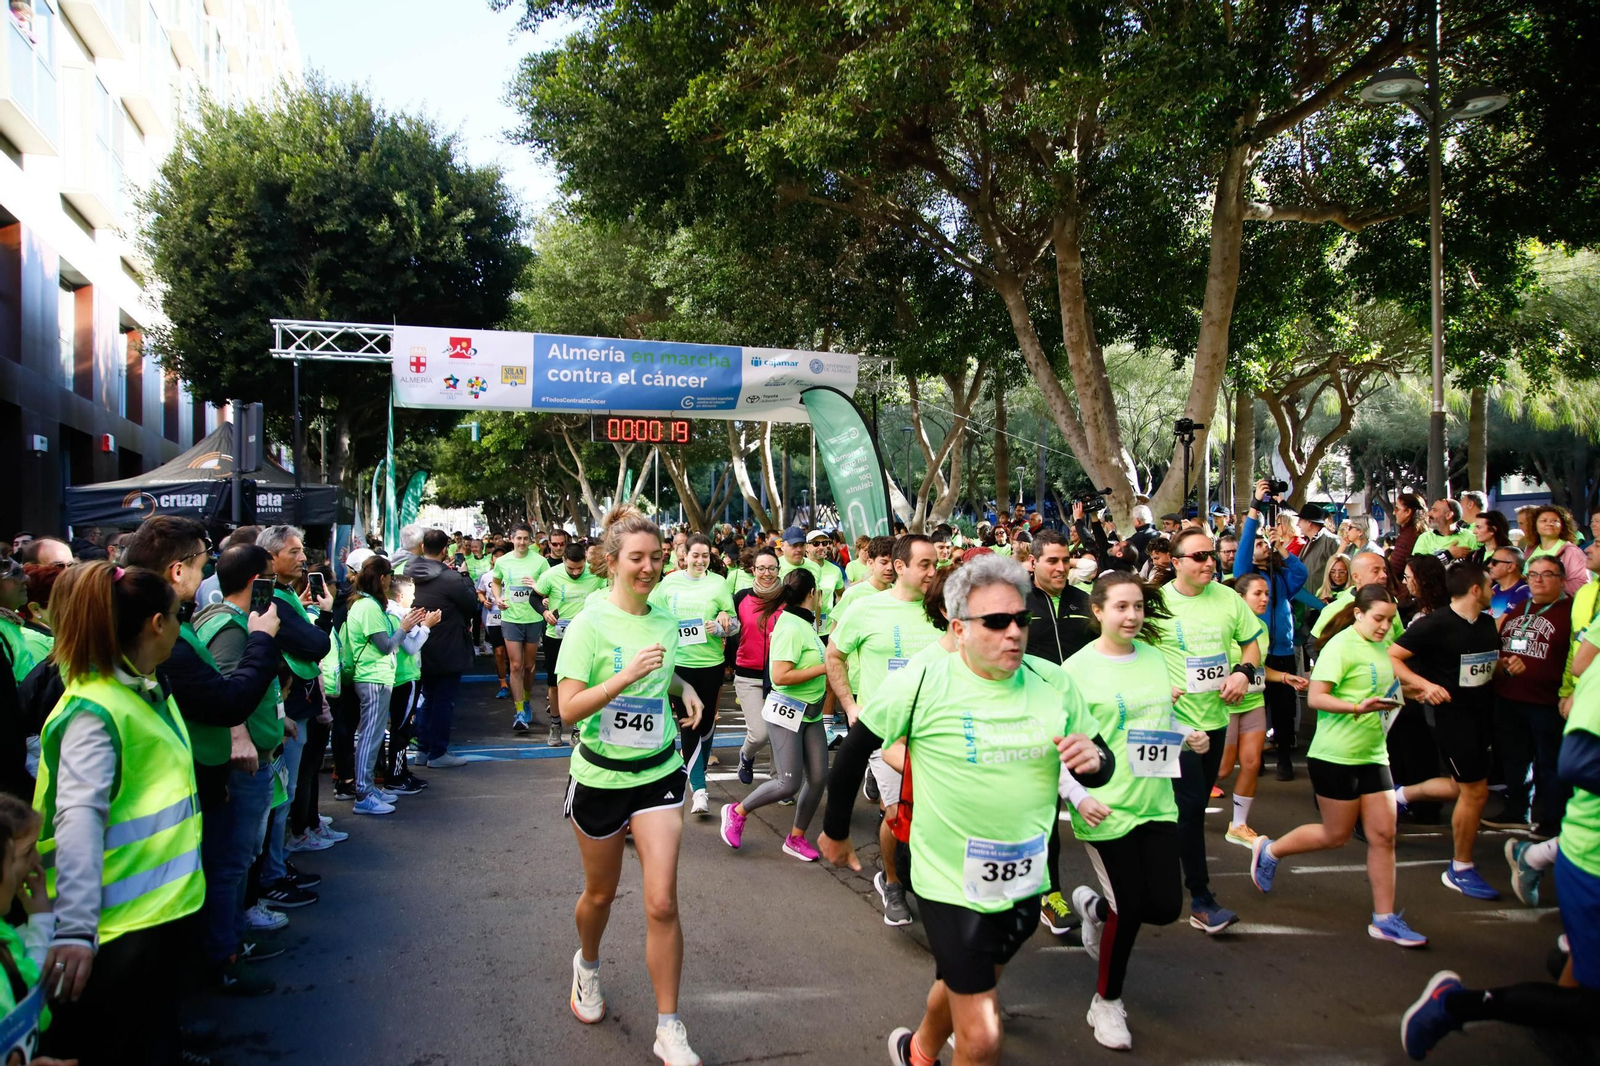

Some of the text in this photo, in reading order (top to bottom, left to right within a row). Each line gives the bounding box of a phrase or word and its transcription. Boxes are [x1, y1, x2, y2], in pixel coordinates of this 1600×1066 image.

[548, 343, 731, 368] Almería en marcha
[764, 358, 799, 368] cajamar
[400, 375, 433, 384] ALMERÍA
[548, 367, 708, 388] contra el cáncer
[541, 396, 606, 405] #TodosContraElCáncer
[160, 494, 209, 507] cruzar
[678, 627, 698, 637] 190
[614, 646, 622, 673] MERÍA
[1196, 666, 1224, 681] 362
[1470, 662, 1492, 676] 646
[772, 702, 796, 719] 165
[614, 712, 654, 732] 546
[960, 710, 977, 764] ALMERÍA
[980, 726, 1047, 746] contra el
[982, 745, 1050, 764] cáncer
[1137, 745, 1168, 761] 191
[970, 840, 994, 849] Almería
[970, 847, 990, 855] contra
[982, 858, 1032, 882] 383
